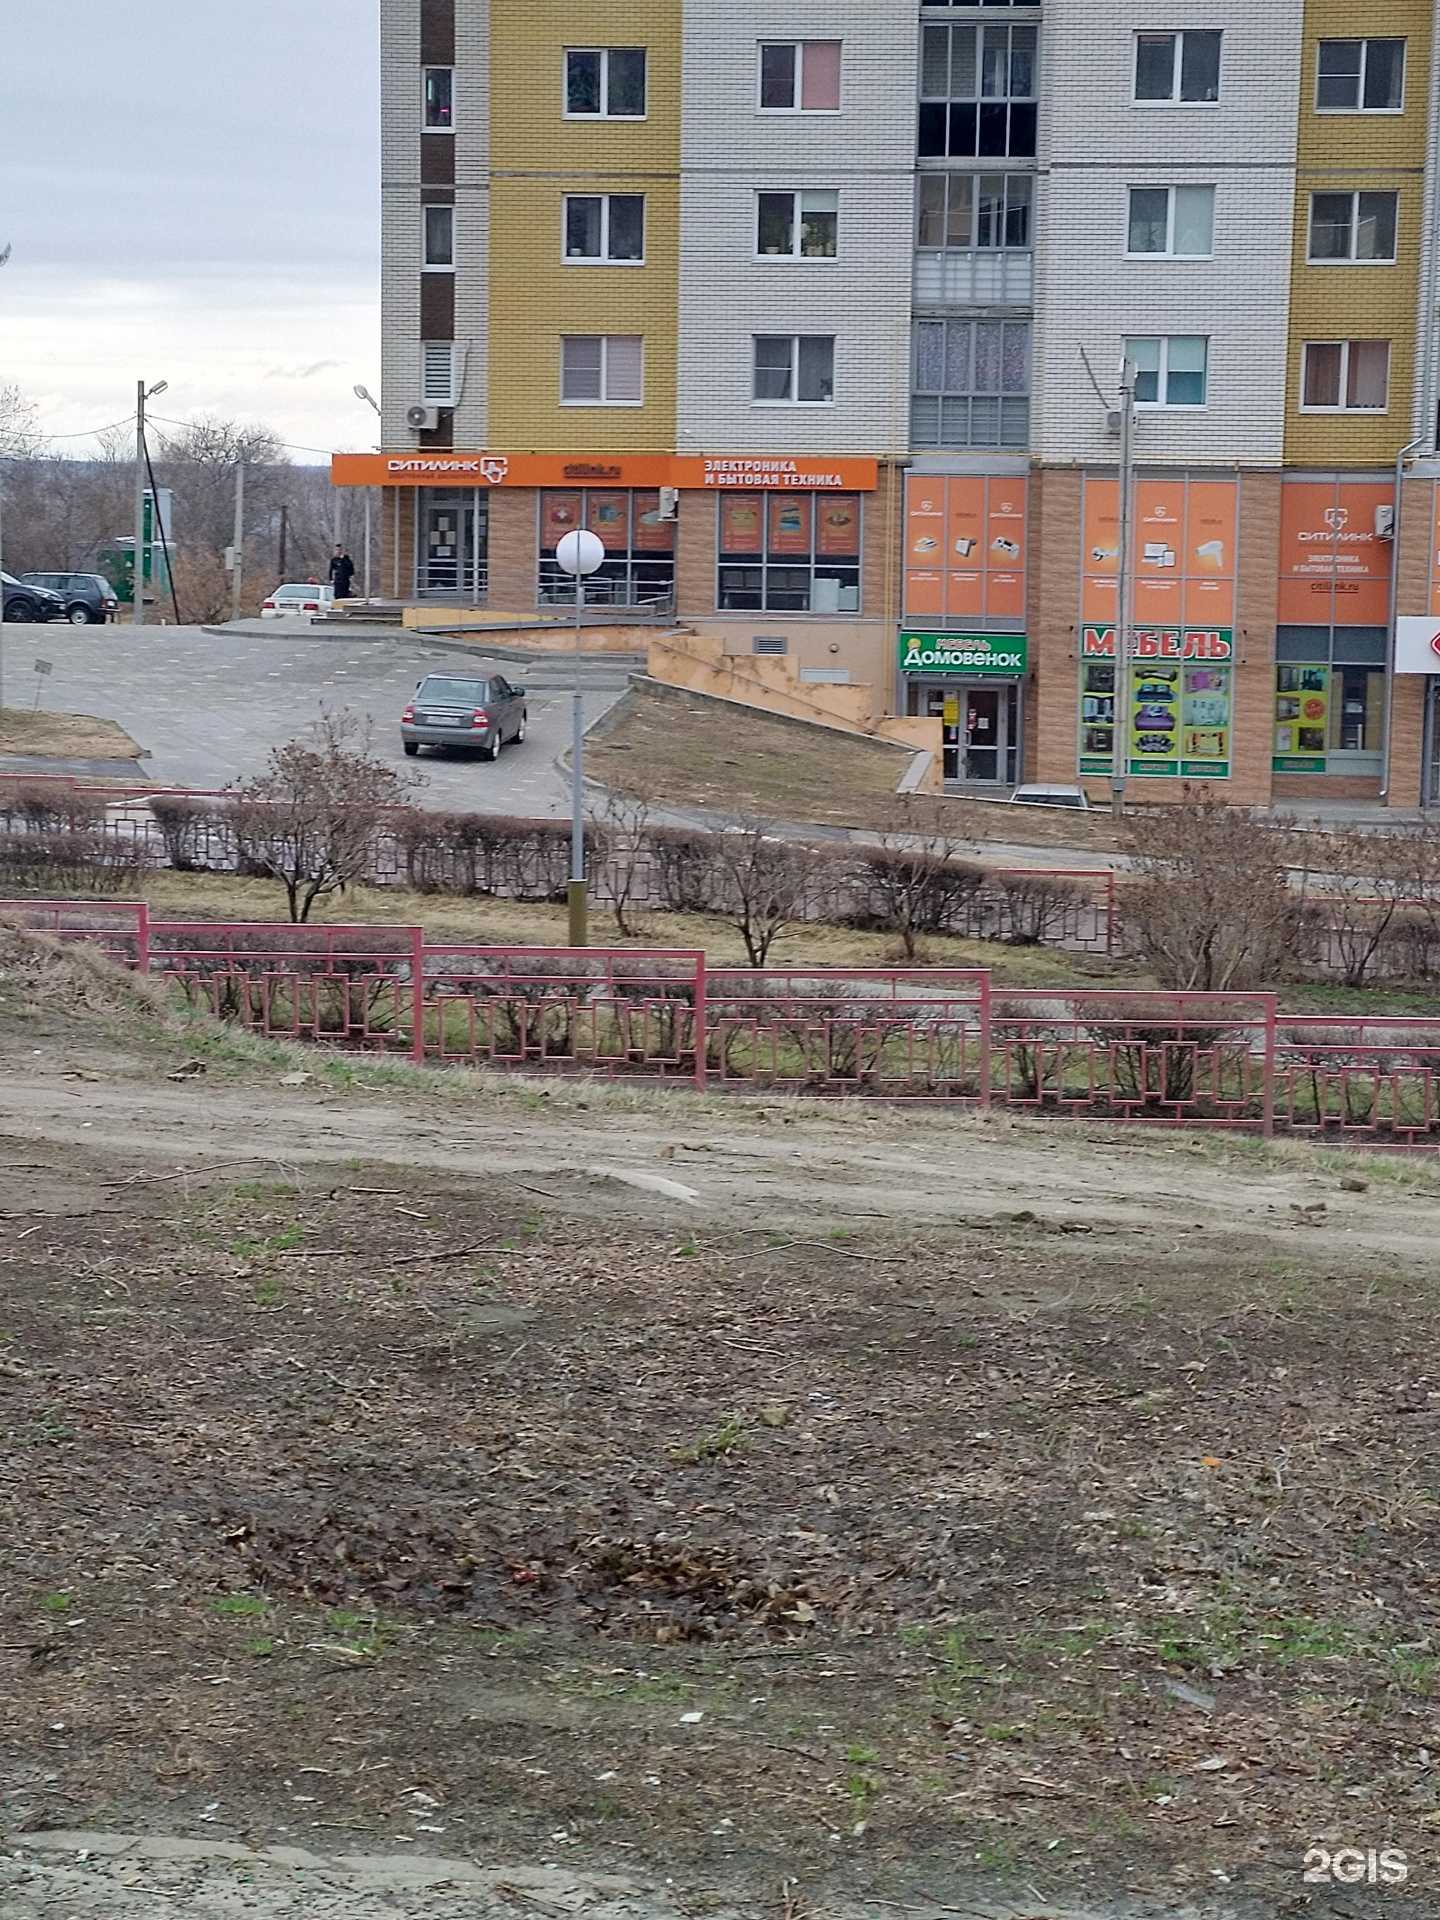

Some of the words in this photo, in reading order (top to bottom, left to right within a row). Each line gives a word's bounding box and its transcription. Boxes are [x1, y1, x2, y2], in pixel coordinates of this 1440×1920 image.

[387, 460, 479, 471] СИТИЛИНК
[704, 460, 797, 472] ЭЛЕКТРОНИКА
[704, 473, 715, 485] И
[718, 473, 779, 485] БЫТОВАЯ
[782, 474, 843, 486] ТЕХНИКА
